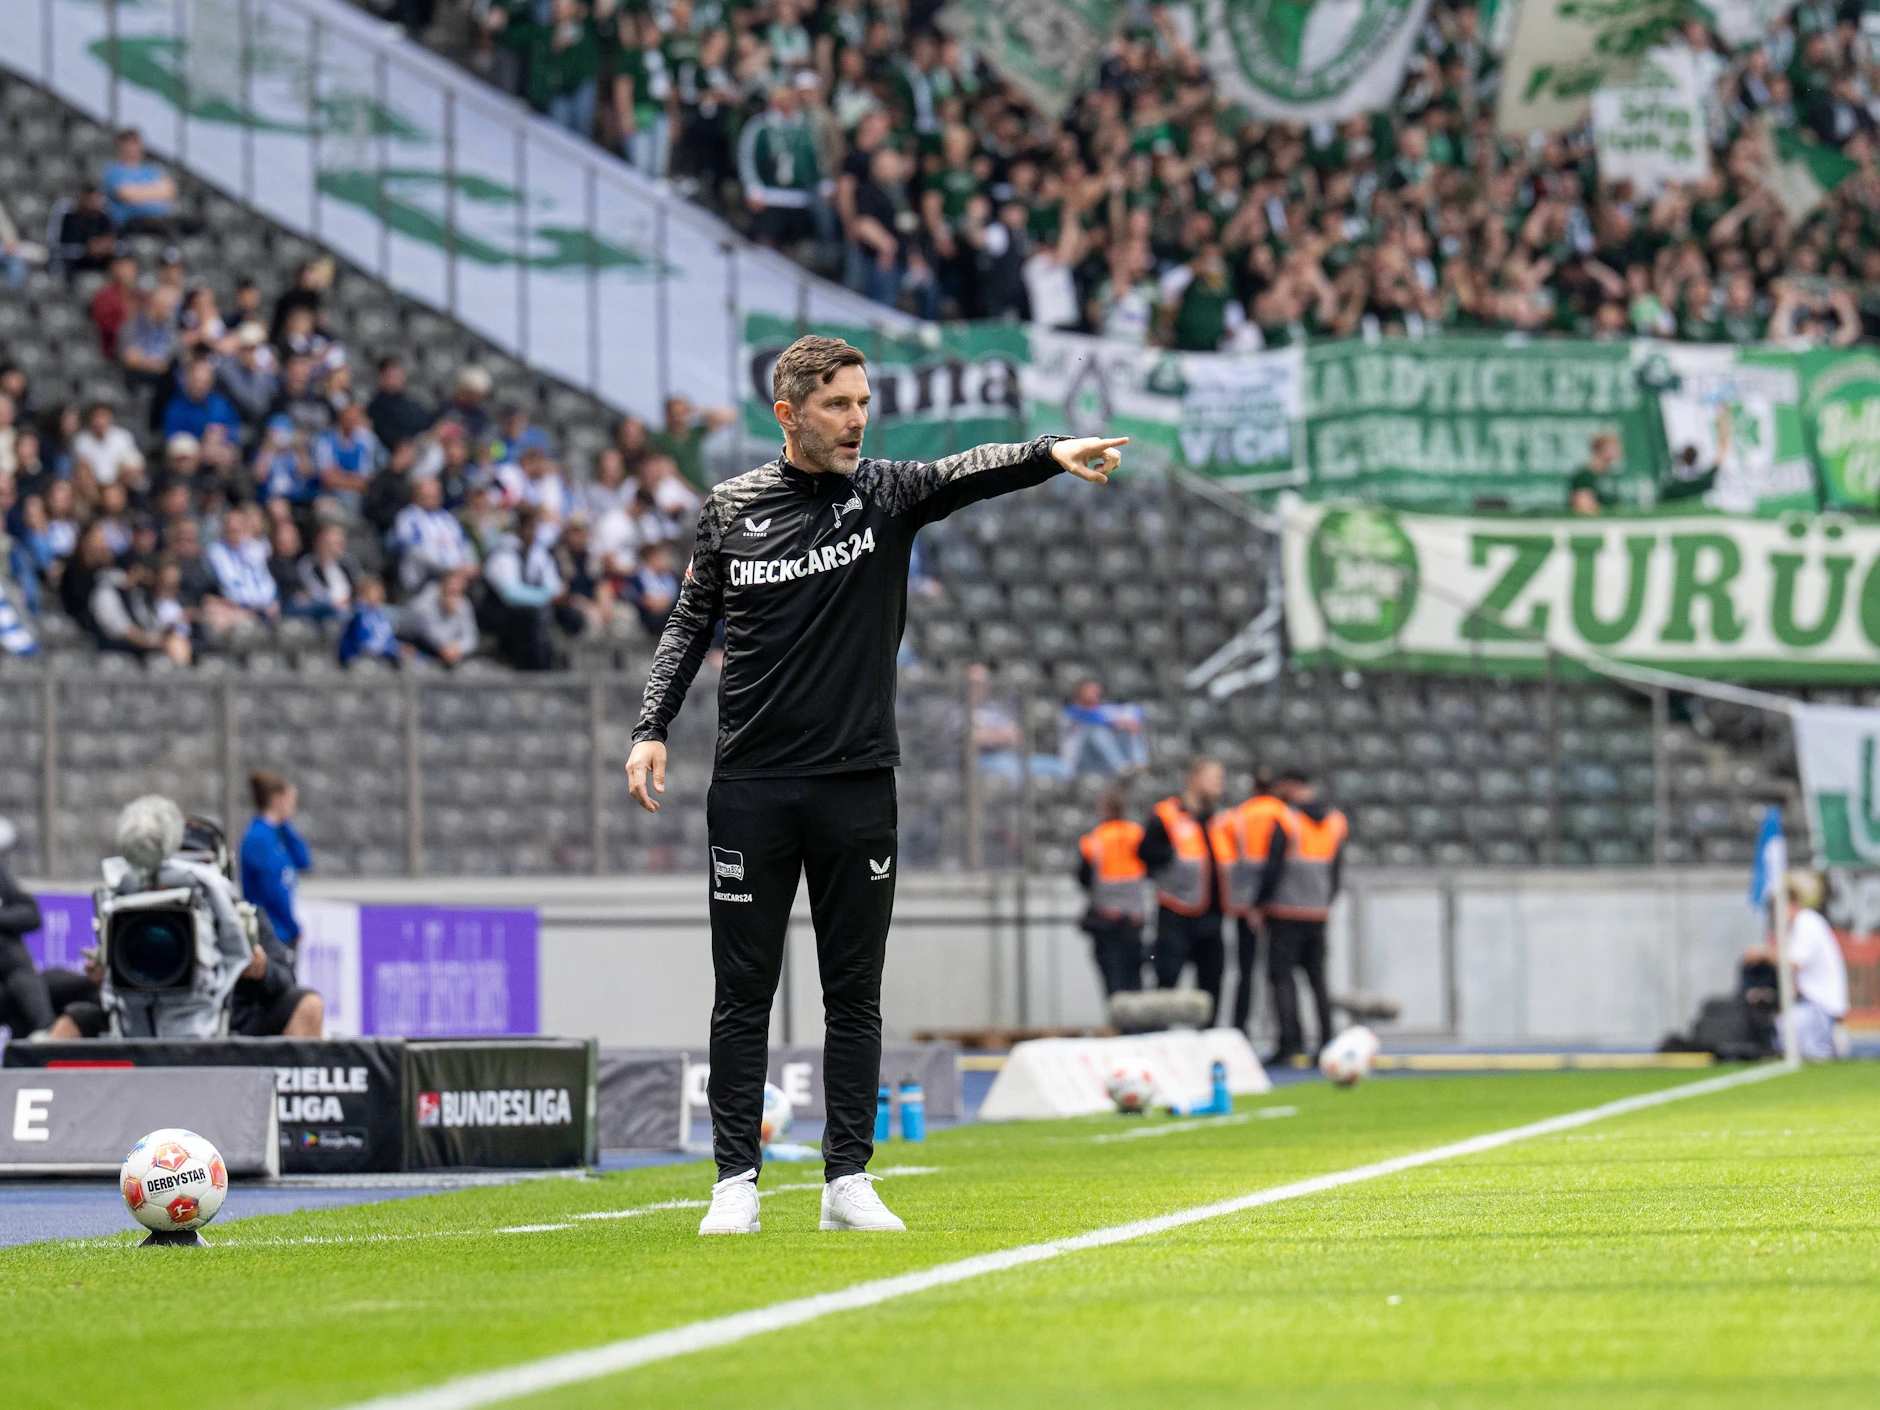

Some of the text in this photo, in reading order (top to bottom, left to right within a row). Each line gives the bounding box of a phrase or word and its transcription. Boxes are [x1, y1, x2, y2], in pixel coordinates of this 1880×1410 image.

[729, 527, 876, 587] CHECKCARS24
[1459, 520, 1880, 648] ZURÜ
[276, 1066, 369, 1093] ZIELLE
[278, 1095, 345, 1122] LIGA
[441, 1088, 572, 1127] BUNDESLIGA
[147, 1168, 206, 1192] DERBYSTAR
